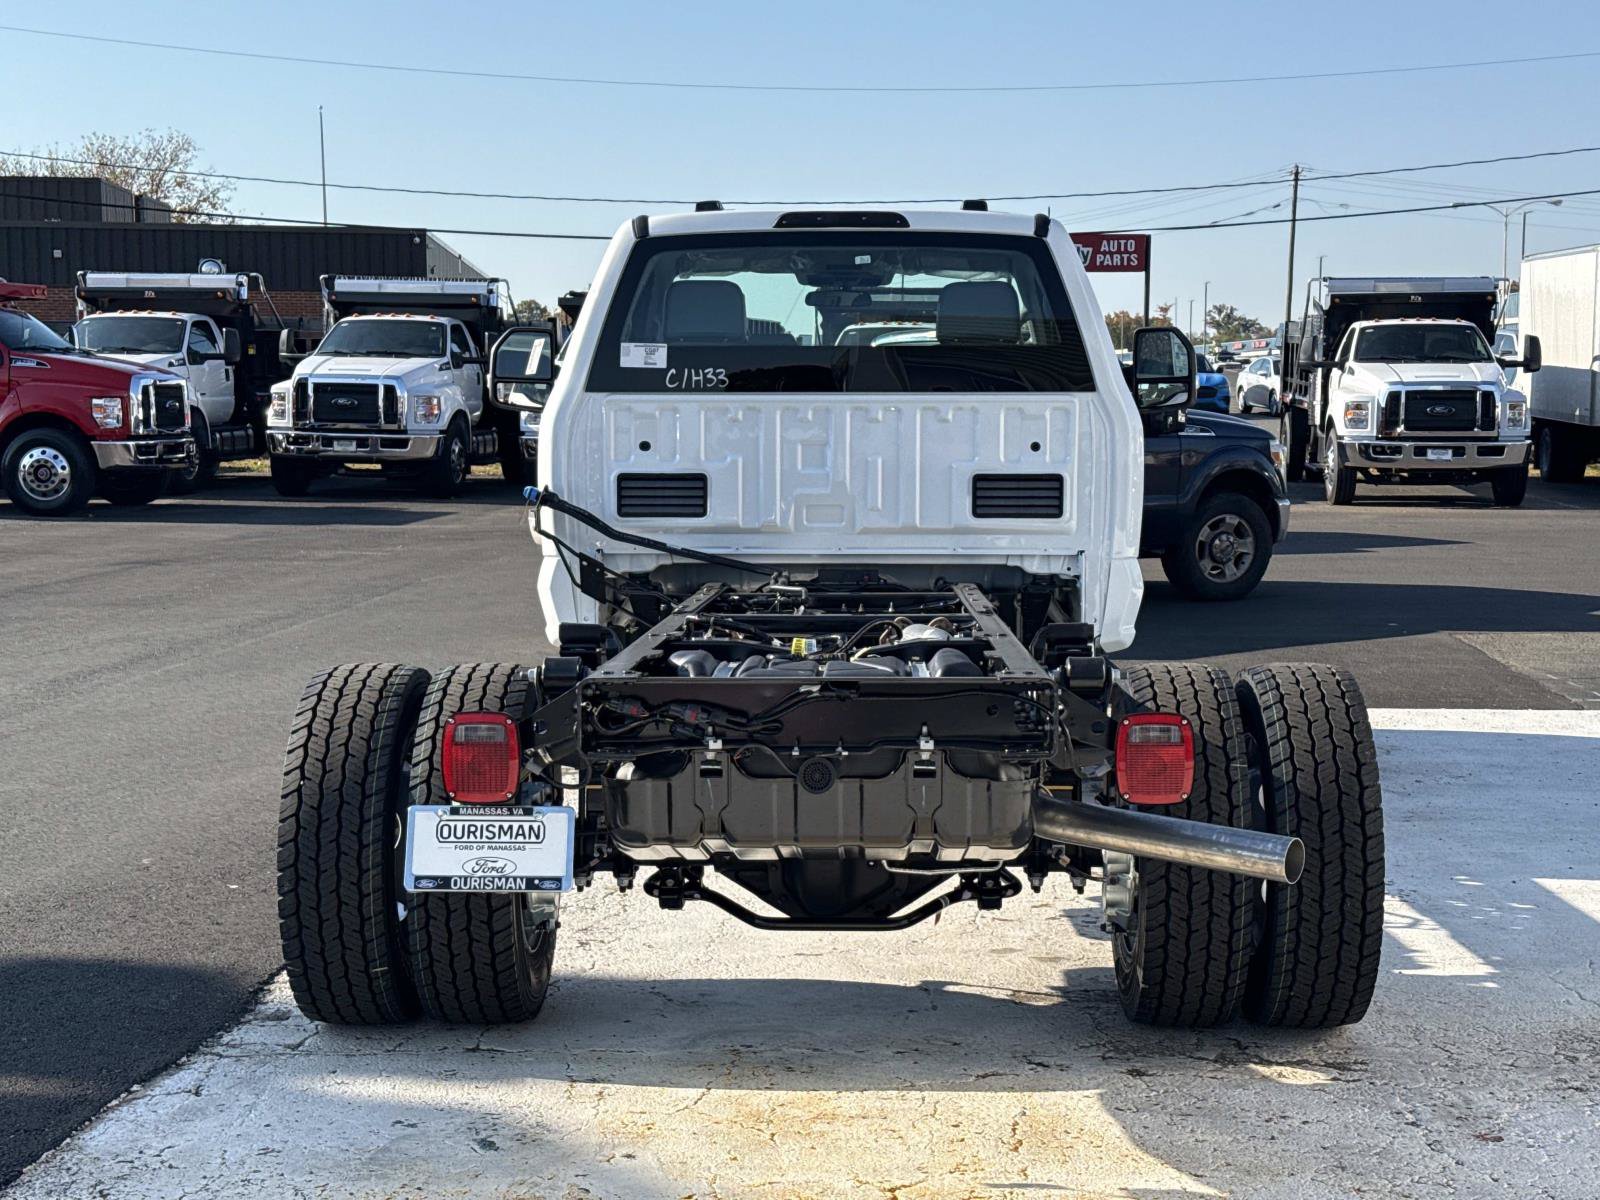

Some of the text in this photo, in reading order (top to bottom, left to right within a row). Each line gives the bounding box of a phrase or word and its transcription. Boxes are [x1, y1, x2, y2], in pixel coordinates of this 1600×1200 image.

[1100, 240, 1136, 252] AUTO
[1096, 254, 1138, 266] PARTS
[439, 823, 541, 841] OURISMAN
[487, 844, 527, 852] MANASSAS
[471, 858, 508, 875] Ford
[450, 877, 526, 890] OURISMAN
